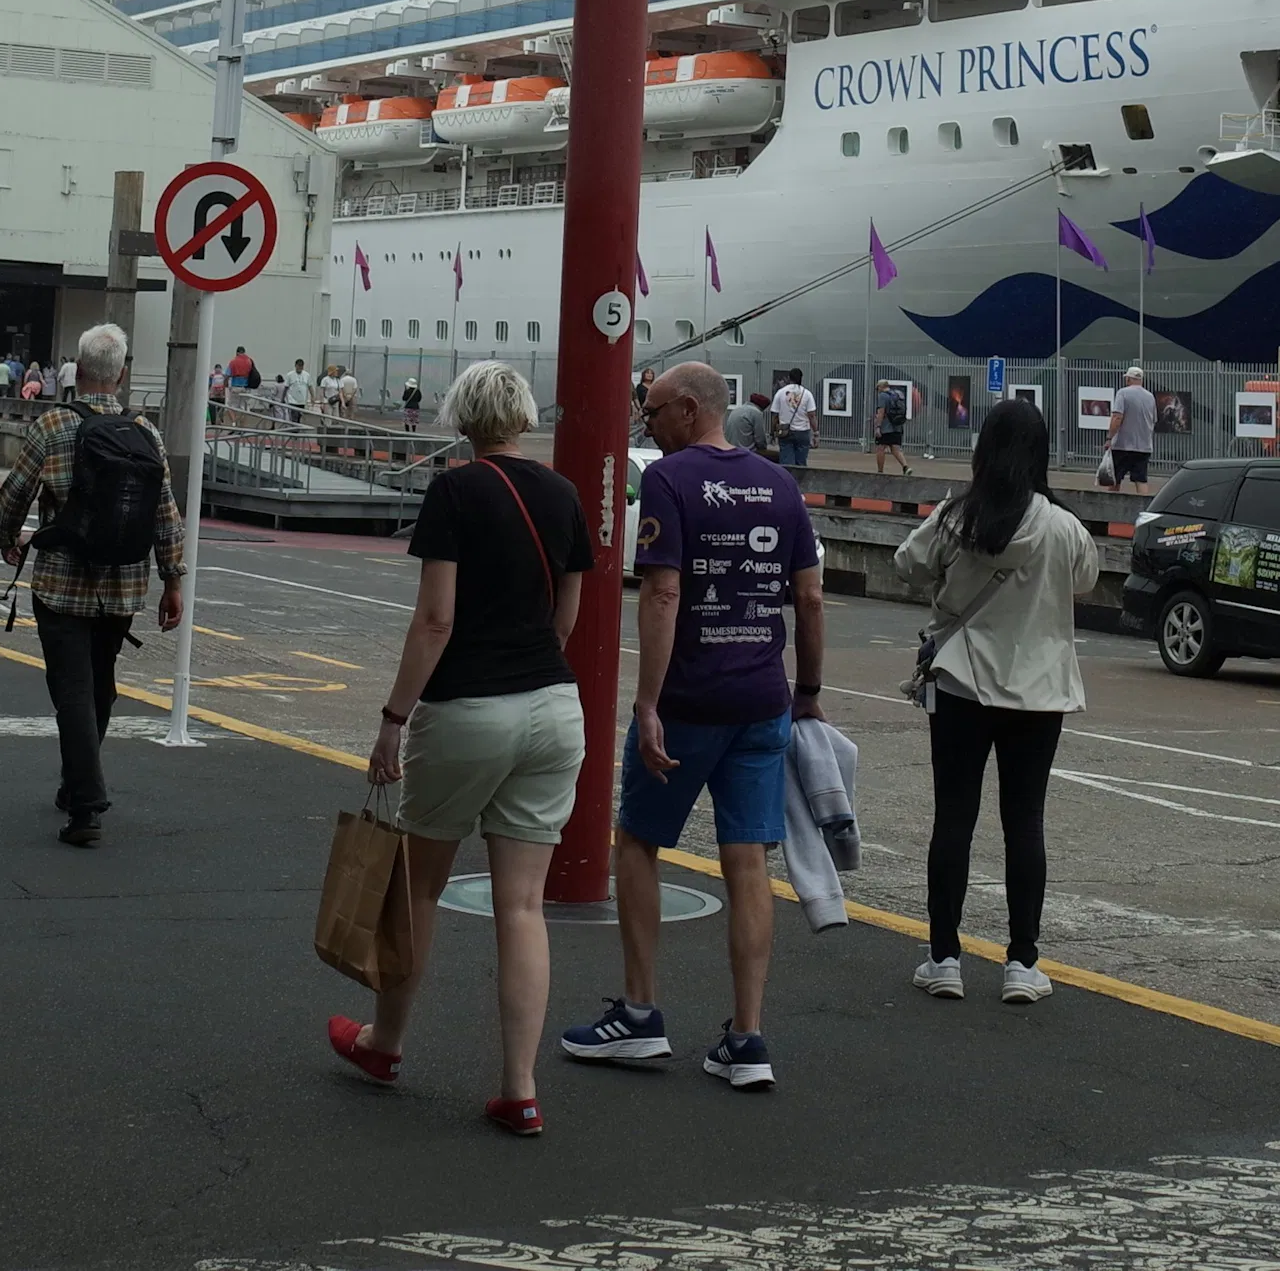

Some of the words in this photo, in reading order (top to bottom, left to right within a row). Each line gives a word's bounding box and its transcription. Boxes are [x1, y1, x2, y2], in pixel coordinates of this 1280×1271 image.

[814, 51, 946, 110] CROWN
[957, 27, 1151, 95] PRINCESS
[606, 302, 621, 326] 5
[993, 360, 1000, 371] P
[744, 495, 772, 503] Harriers
[691, 604, 731, 612] SILVERHAND
